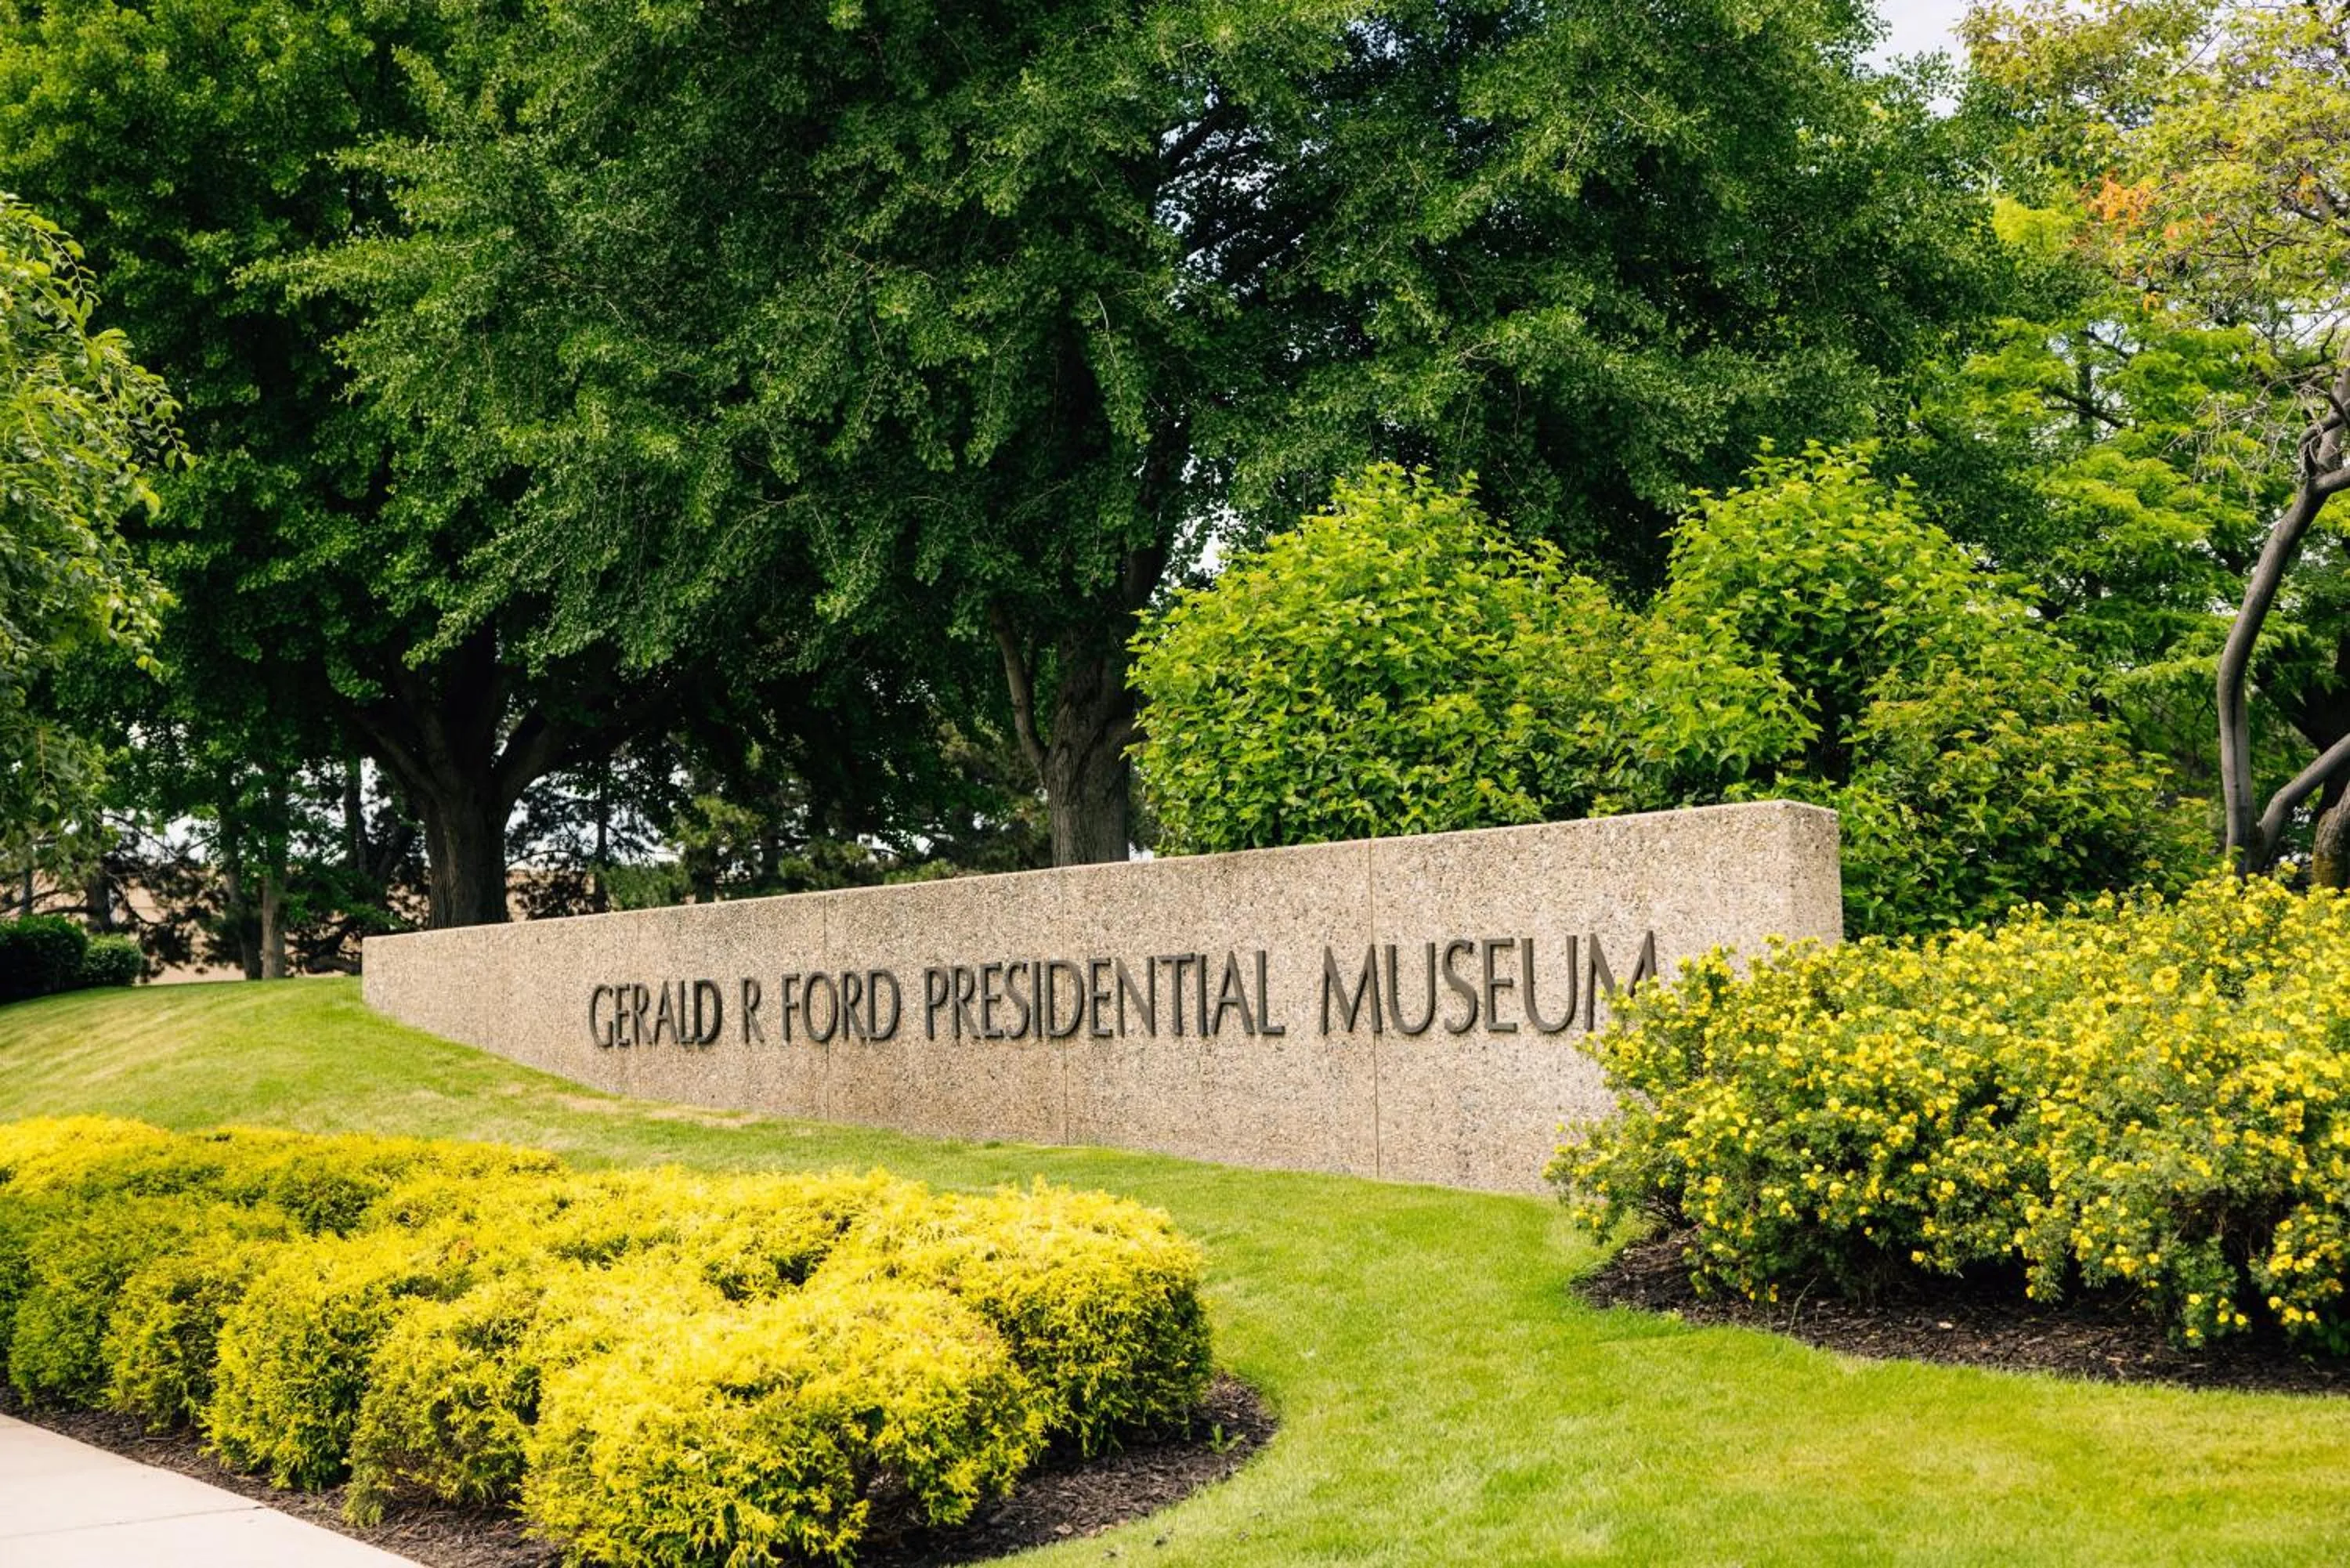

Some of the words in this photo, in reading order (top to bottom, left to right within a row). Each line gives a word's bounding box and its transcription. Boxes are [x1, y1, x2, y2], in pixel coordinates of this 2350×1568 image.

[588, 977, 723, 1048] GERALD
[740, 976, 765, 1044] R
[782, 967, 902, 1042] FORD
[923, 949, 1285, 1042] PRESIDENTIAL
[1318, 930, 1658, 1035] MUSEUM
